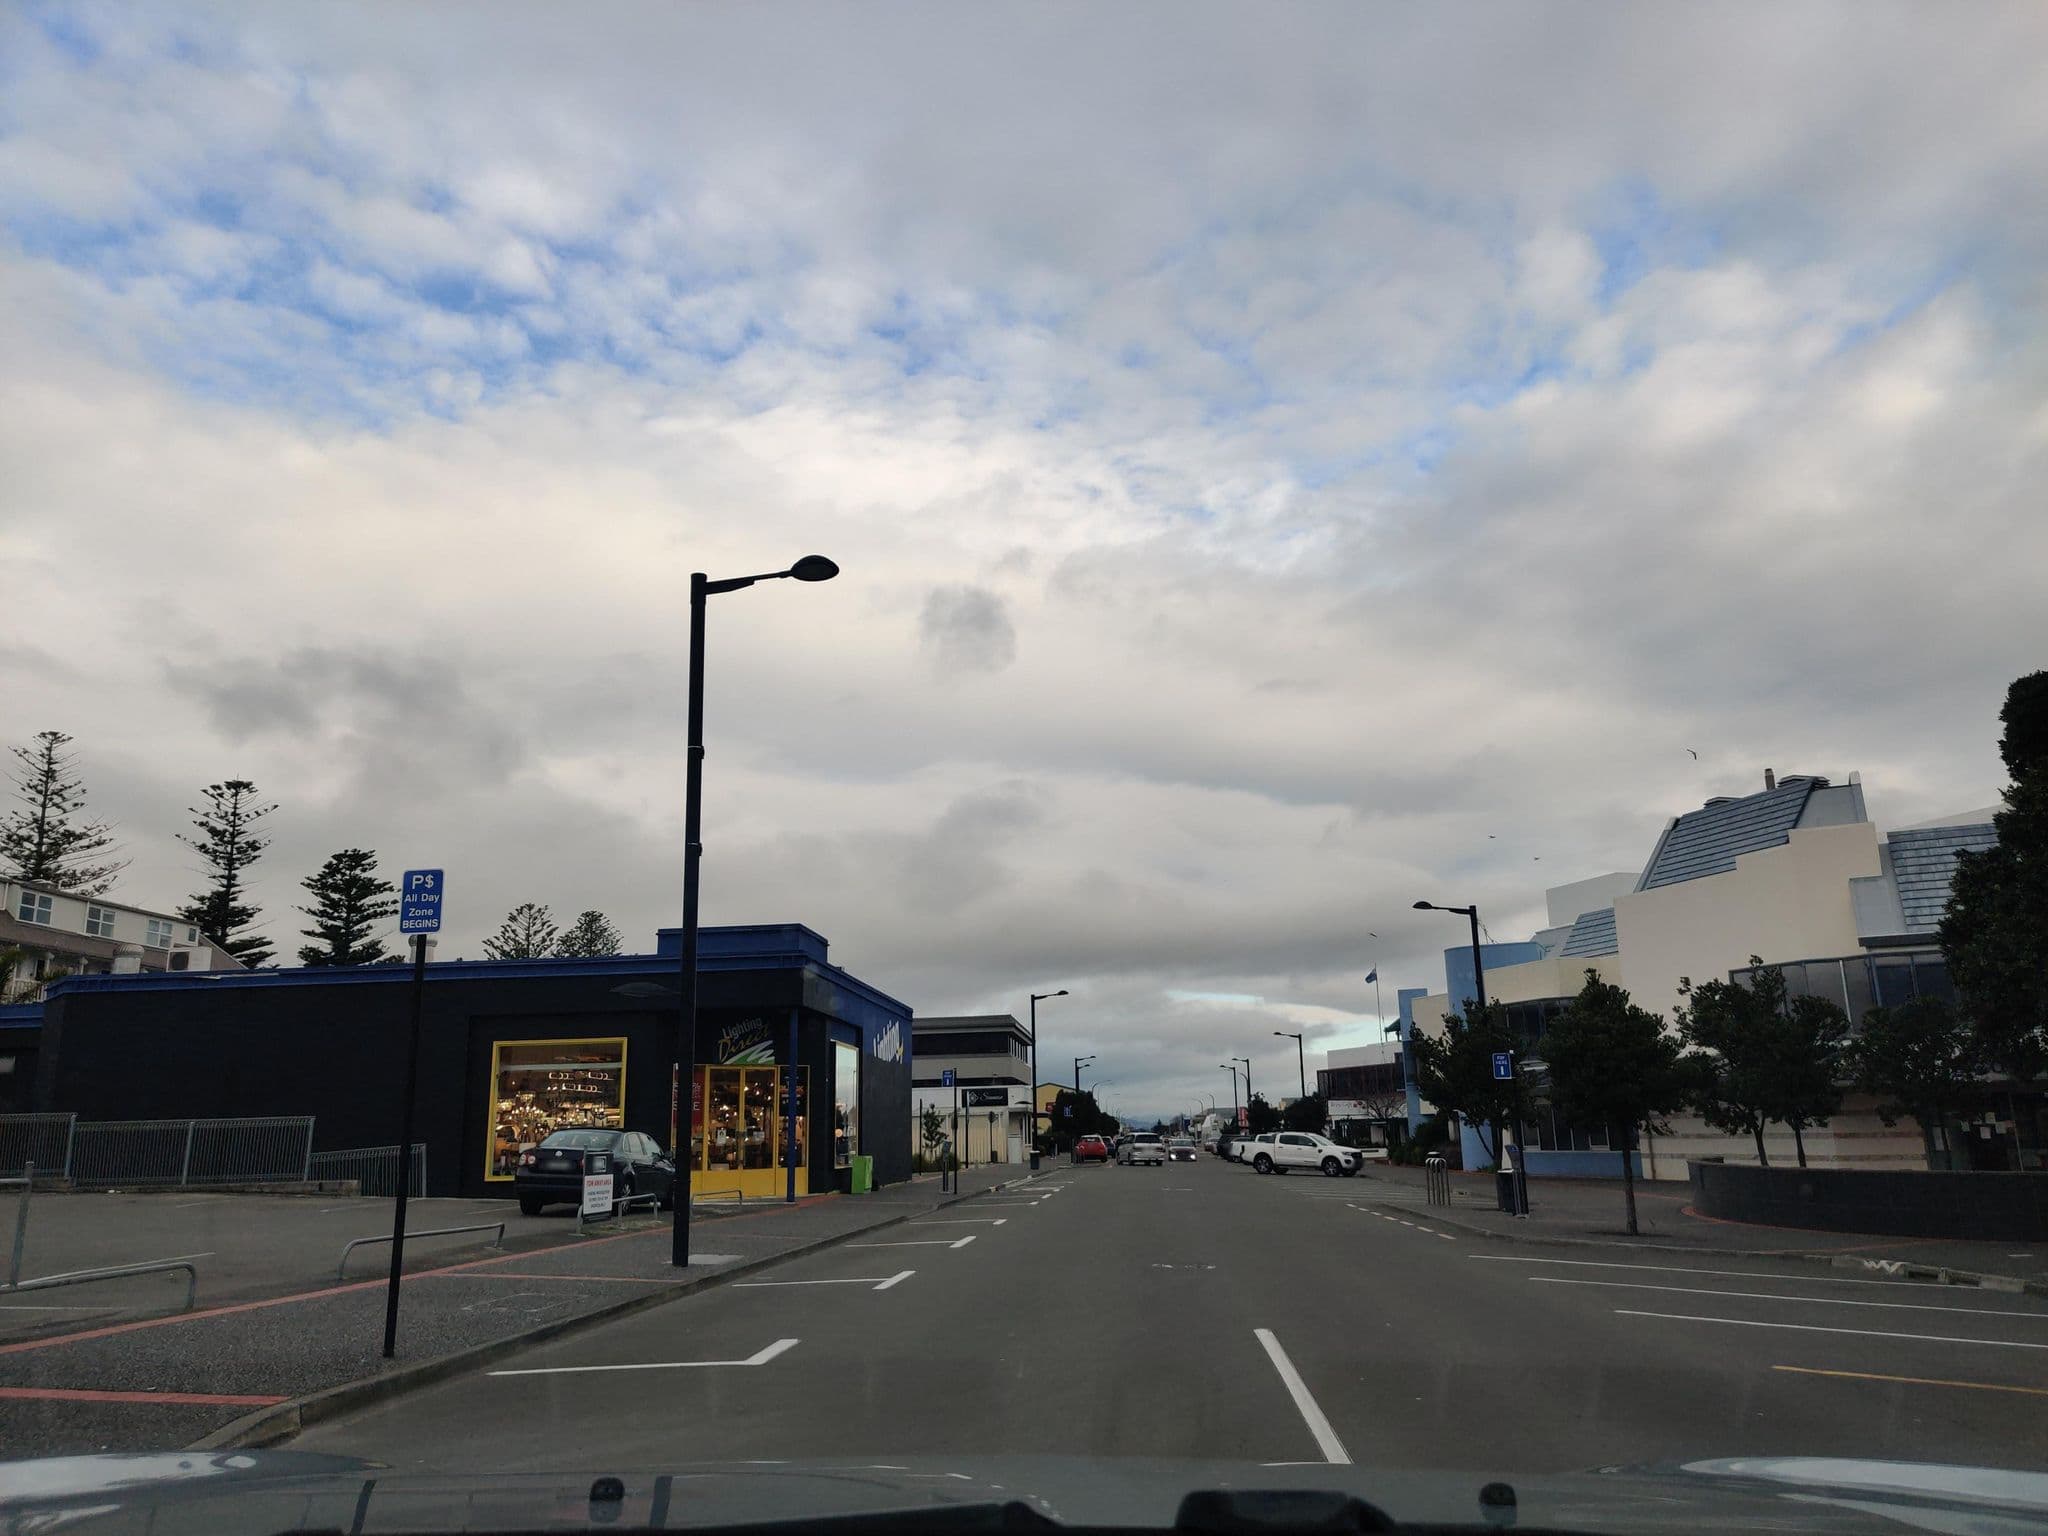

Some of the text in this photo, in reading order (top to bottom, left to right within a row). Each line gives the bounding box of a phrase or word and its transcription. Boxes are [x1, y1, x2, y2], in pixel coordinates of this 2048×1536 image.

[412, 874, 434, 890] P$
[404, 893, 440, 903] All Day
[408, 907, 434, 917] Zone
[402, 918, 439, 929] BEGINS
[722, 1017, 762, 1040] Lighting
